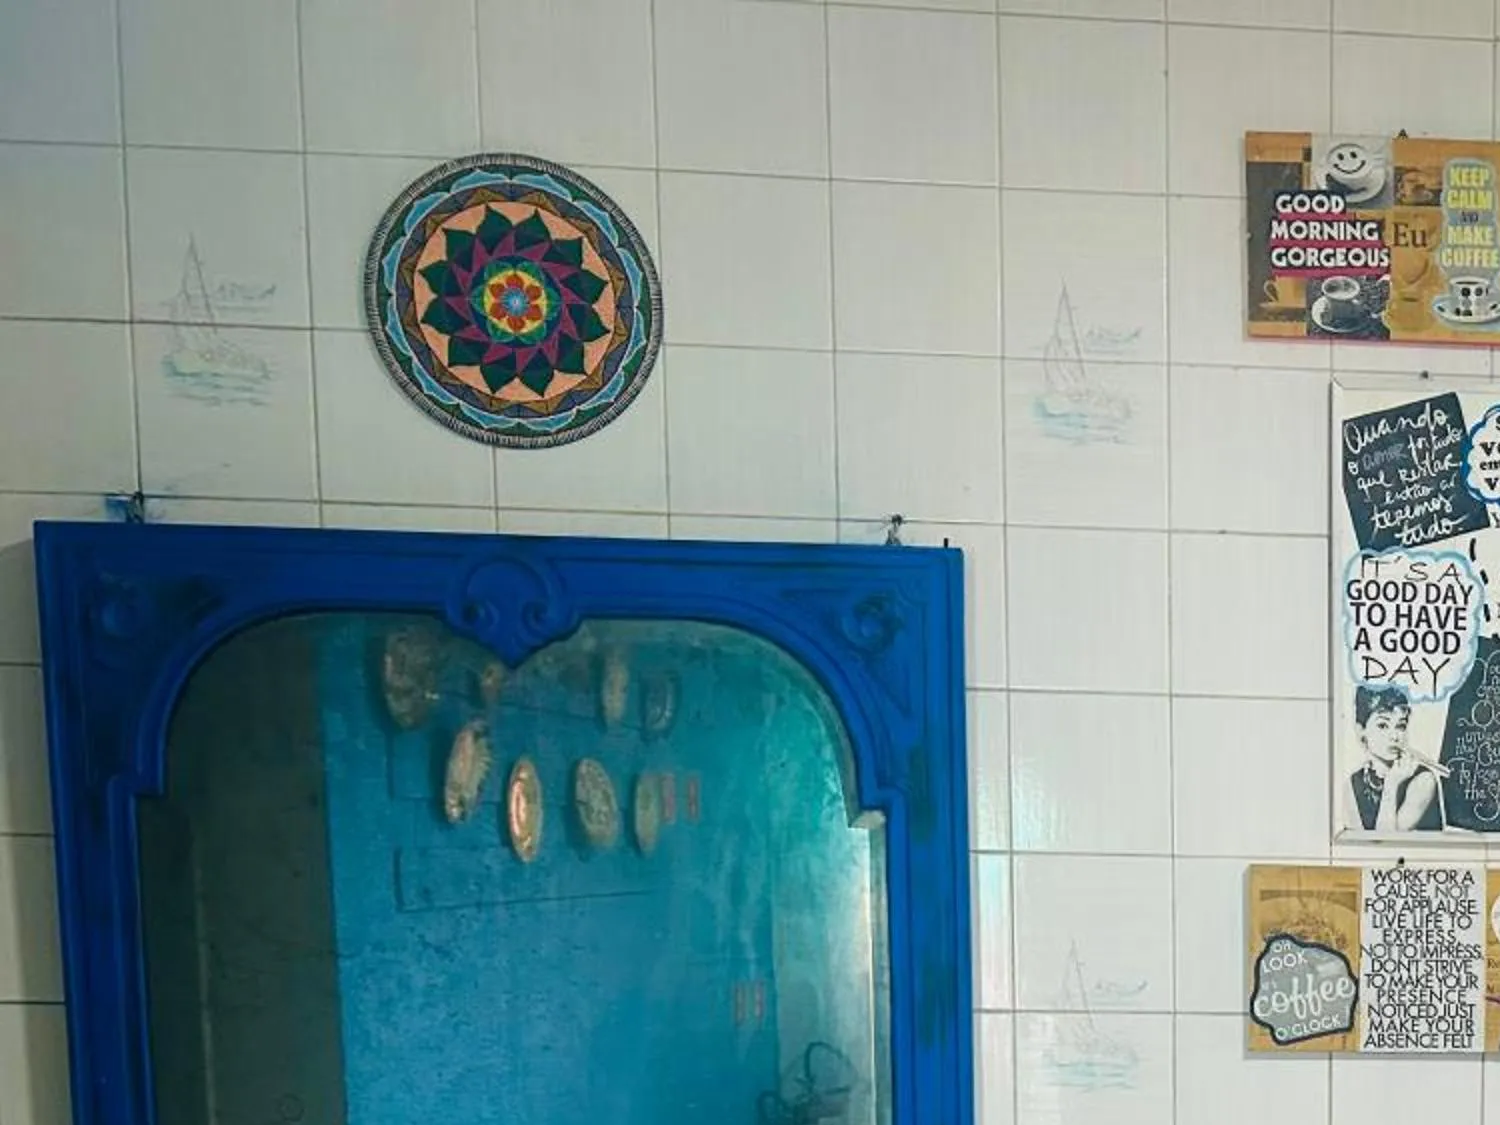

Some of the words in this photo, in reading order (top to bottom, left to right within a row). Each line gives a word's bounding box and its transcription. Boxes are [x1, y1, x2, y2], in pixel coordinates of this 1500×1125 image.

[1450, 167, 1490, 188] KEEP
[1275, 193, 1345, 214] GOOD
[1448, 190, 1493, 210] CALM
[1271, 219, 1379, 241] MORNING
[1392, 221, 1428, 247] Eu
[1448, 226, 1494, 247] MAKE
[1271, 246, 1390, 267] GORGEOUS
[1441, 248, 1499, 268] COFFEE
[1343, 402, 1448, 455] Quando
[1436, 563, 1462, 584] A
[1346, 579, 1418, 602] GOOD
[1425, 582, 1474, 606] DAY
[1349, 601, 1386, 627] TO
[1395, 603, 1467, 631] HAVE
[1353, 628, 1372, 651] A
[1379, 628, 1461, 655] GOOD
[1361, 655, 1451, 697] DAY
[1371, 868, 1423, 884] WORK
[1427, 869, 1458, 884] FOR
[1462, 870, 1475, 884] A
[1435, 884, 1470, 899] NOT
[1365, 898, 1396, 913] FOR
[1372, 913, 1406, 928] LIVE
[1413, 913, 1443, 928] LIFE
[1448, 913, 1472, 930] TO
[1360, 943, 1392, 958] NOT
[1396, 943, 1417, 958] TO
[1424, 959, 1472, 974] STRIVE
[1364, 973, 1386, 988] TO
[1389, 973, 1434, 988] MAKE
[1436, 973, 1478, 989] YOUR
[1254, 973, 1356, 1019] coffee
[1377, 988, 1466, 1003] PRESENCE
[1440, 1003, 1476, 1018] JUST
[1370, 1018, 1420, 1032] MAKE
[1425, 1017, 1475, 1034] YOUR
[1364, 1033, 1439, 1048] ABSENCE
